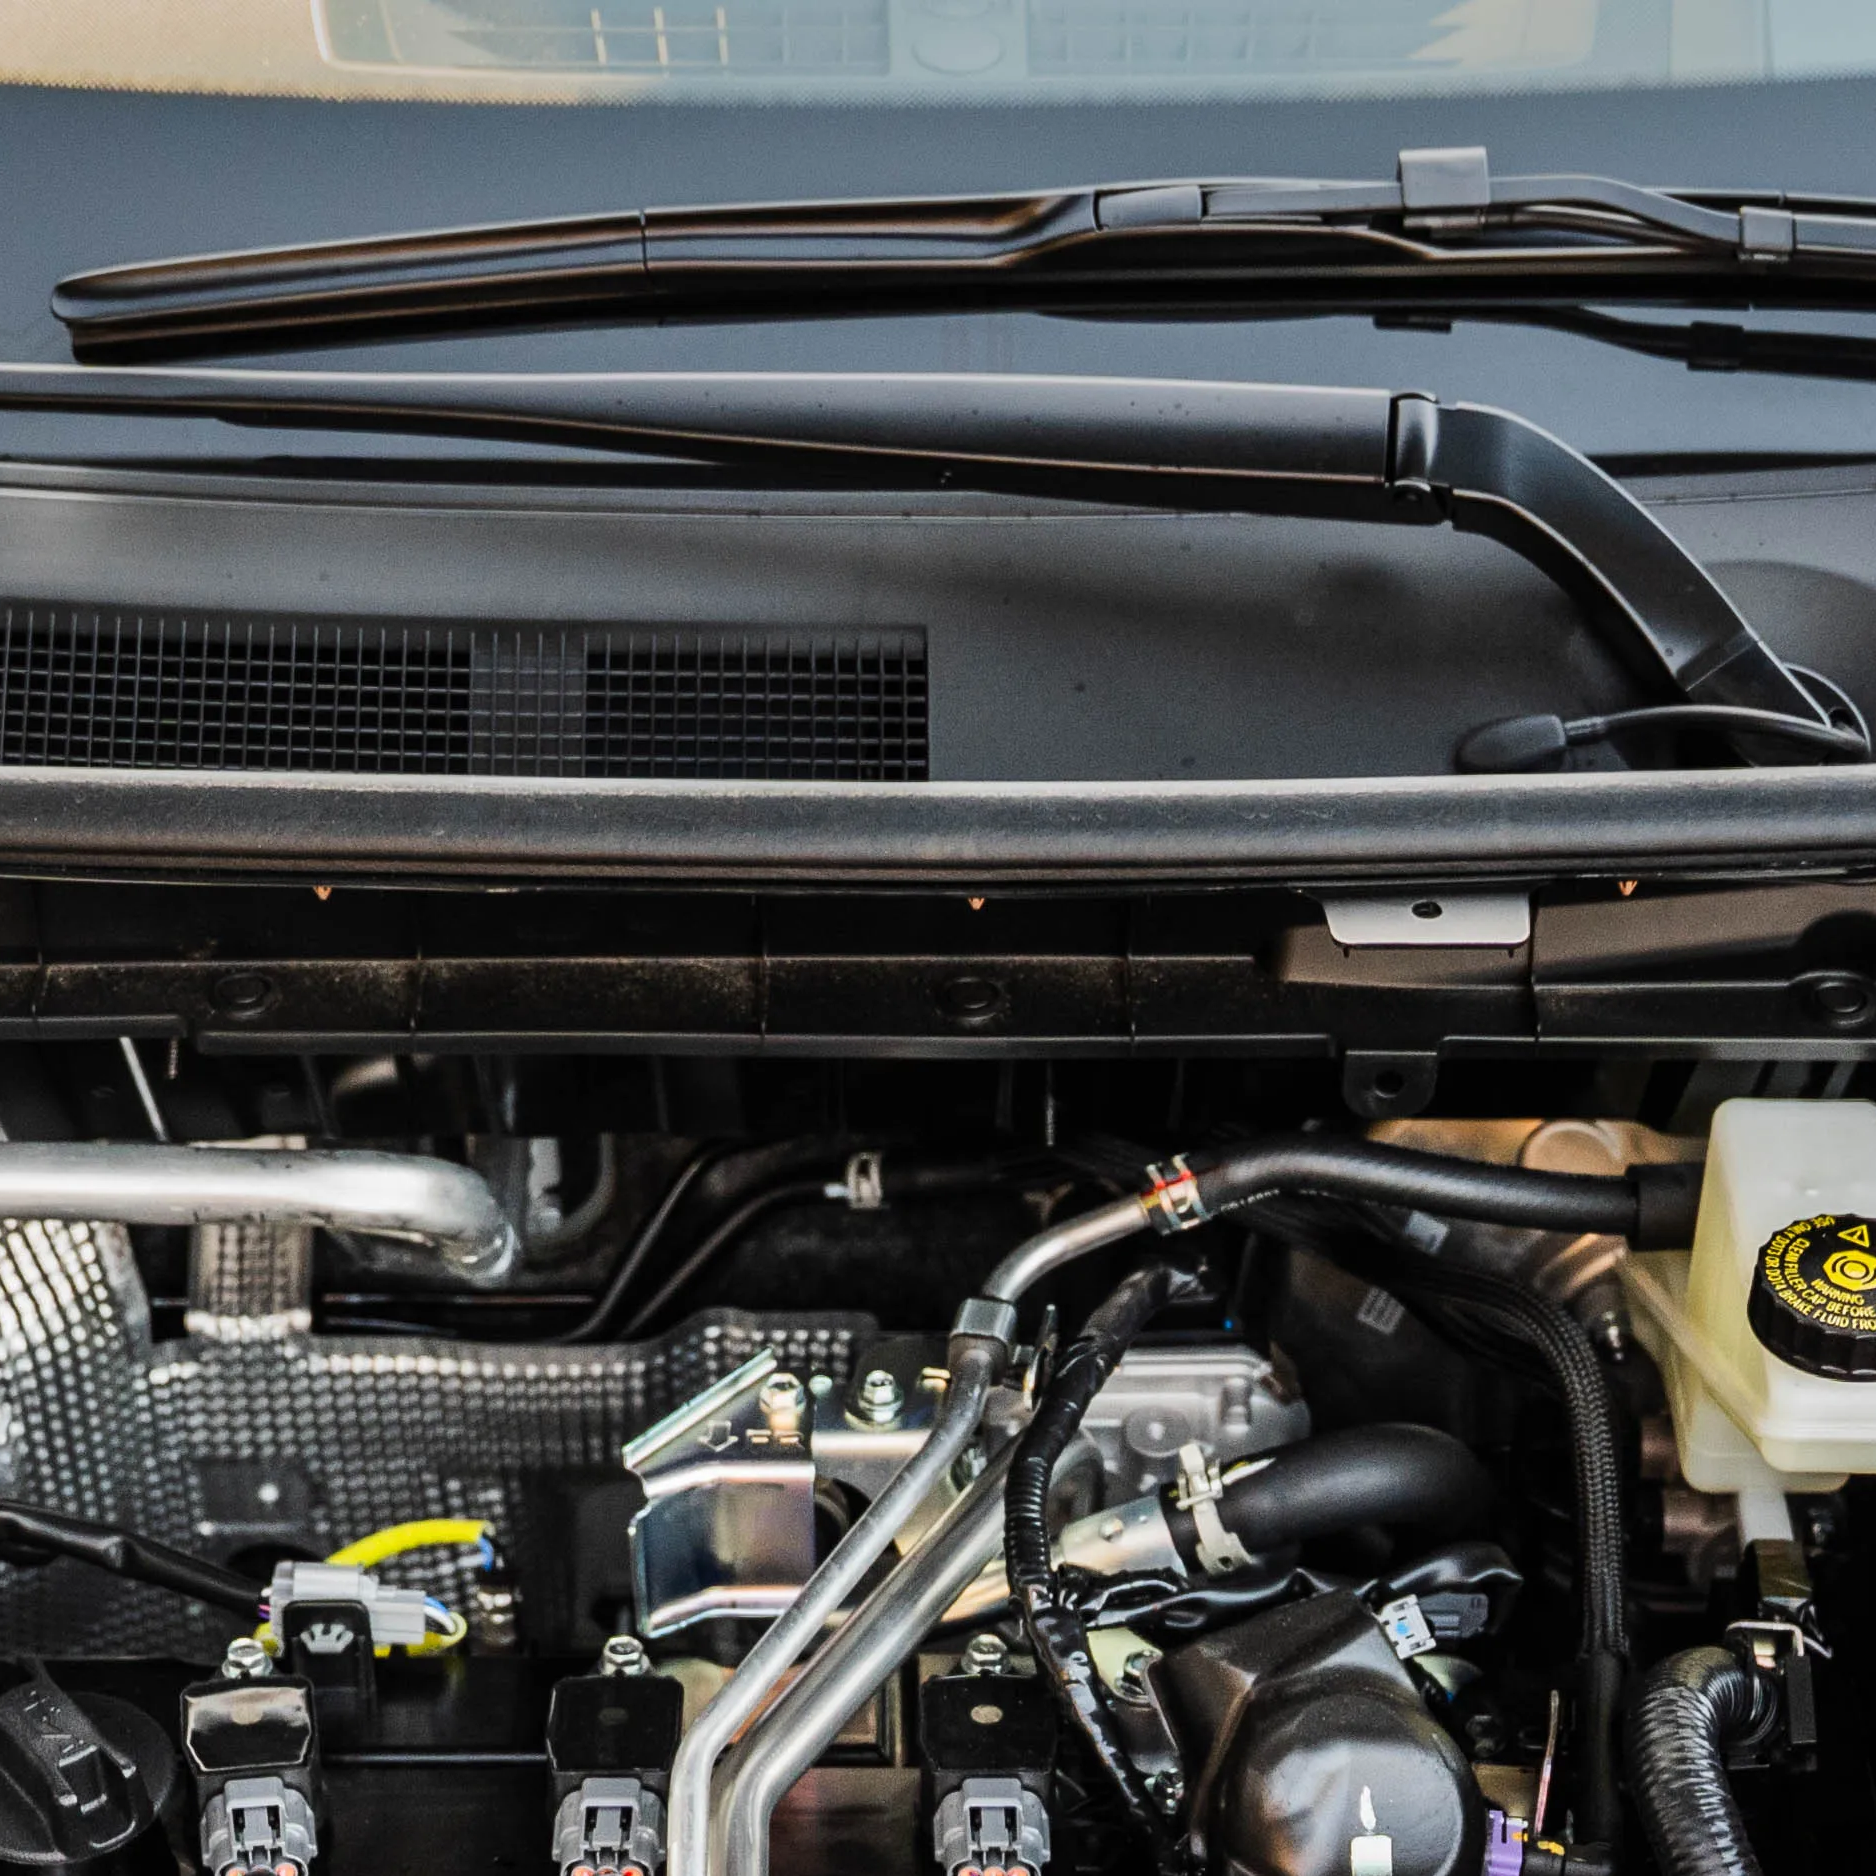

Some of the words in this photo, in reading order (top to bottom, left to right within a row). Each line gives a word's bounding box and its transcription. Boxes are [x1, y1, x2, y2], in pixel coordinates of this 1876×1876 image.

[1801, 1289, 1827, 1305] CAP
[1825, 1301, 1876, 1318] BEFORE
[1810, 1278, 1865, 1306] WARNING
[1778, 1289, 1815, 1316] BRAKE
[1812, 1309, 1849, 1328] FLUID
